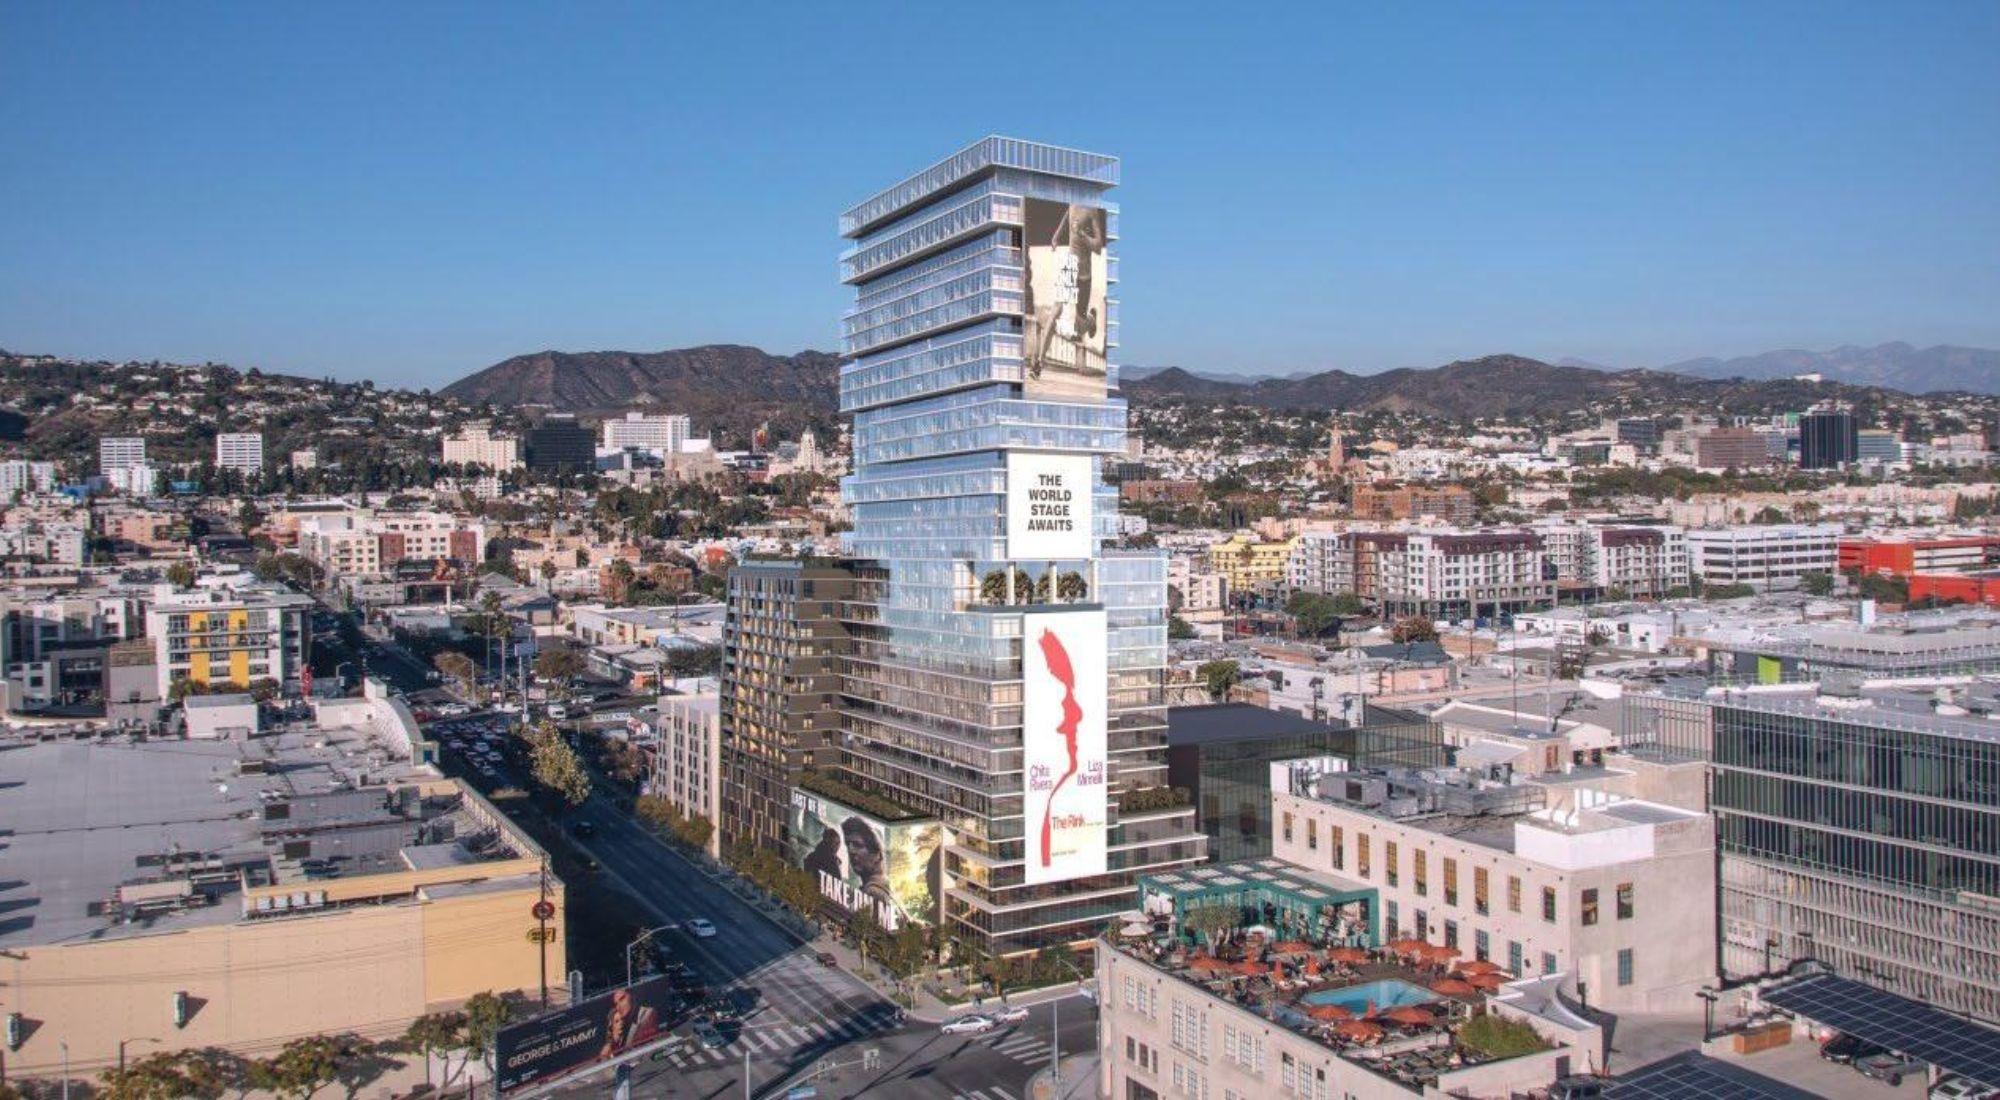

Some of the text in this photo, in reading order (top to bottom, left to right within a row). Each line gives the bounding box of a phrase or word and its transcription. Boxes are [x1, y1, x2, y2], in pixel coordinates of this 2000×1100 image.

[1038, 474, 1062, 486] THE
[1028, 489, 1072, 501] WORLD
[1030, 504, 1070, 516] STAGE
[1027, 519, 1073, 532] AWAITS
[818, 869, 850, 909] TAKE
[508, 1044, 552, 1068] GEORGE
[560, 1027, 597, 1049] TAMMY
